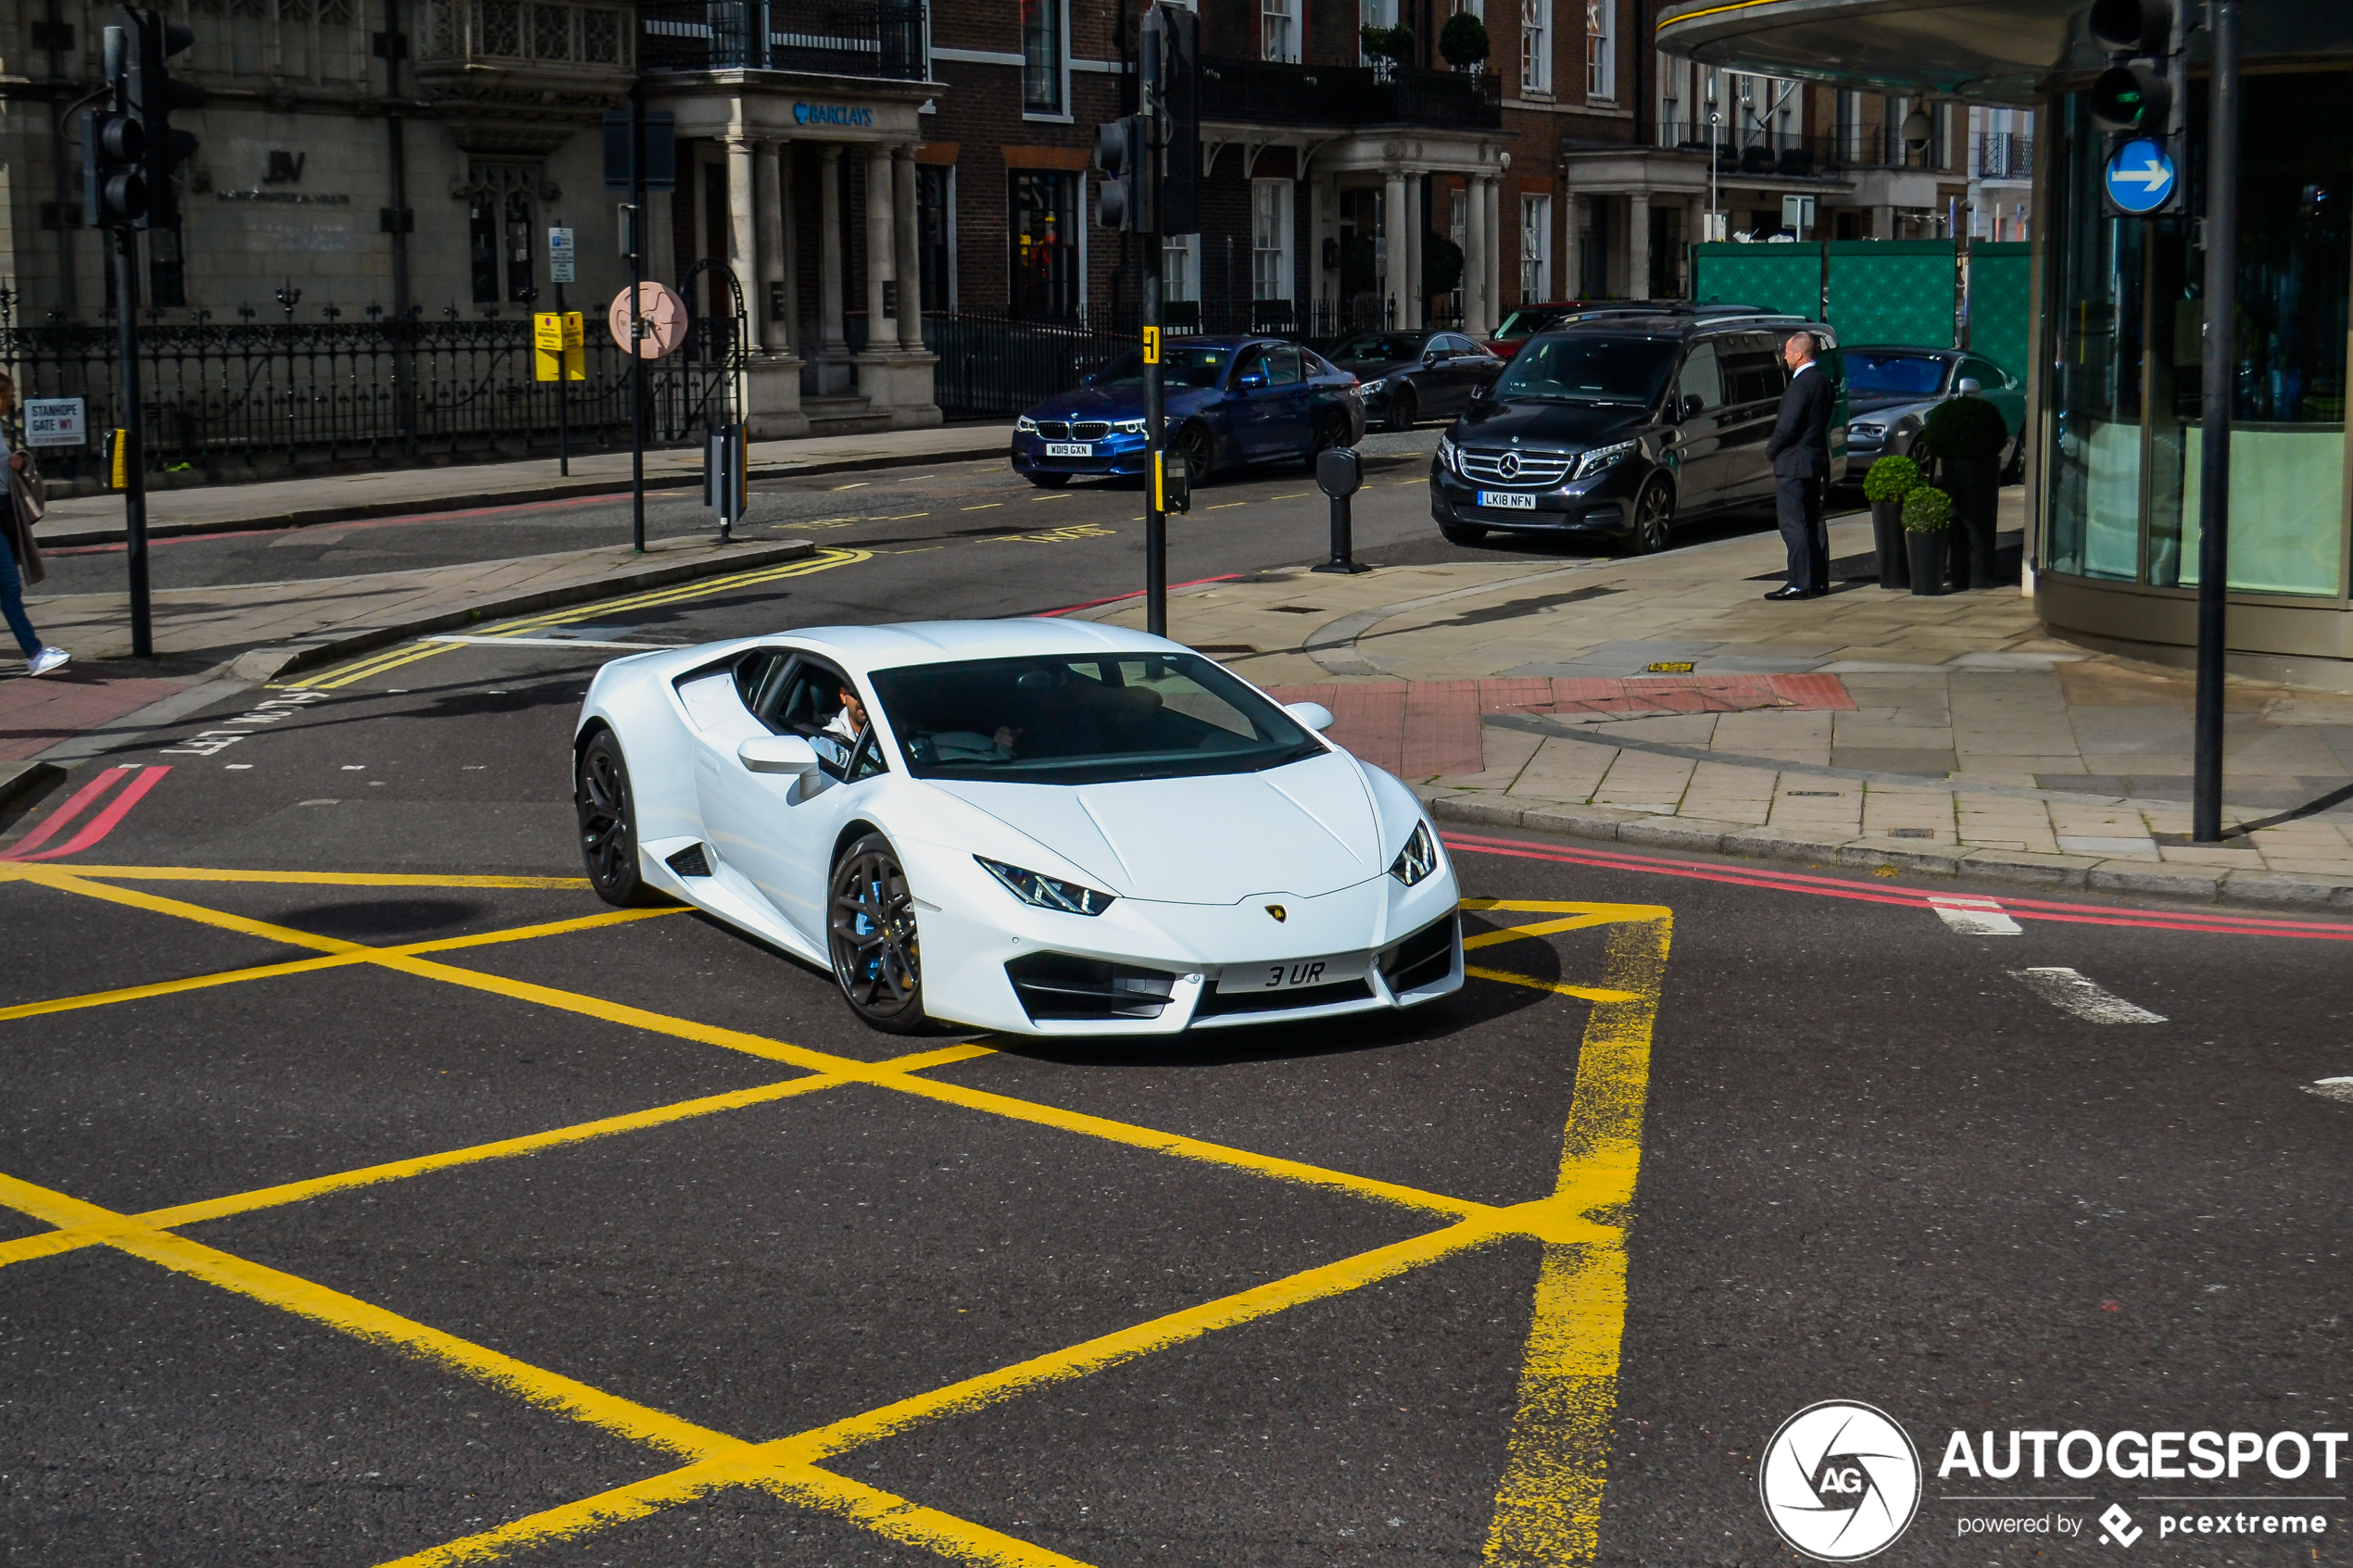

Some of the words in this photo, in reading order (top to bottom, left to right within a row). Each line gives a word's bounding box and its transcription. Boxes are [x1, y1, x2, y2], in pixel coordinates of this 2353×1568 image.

[811, 105, 874, 126] BARCLAYS
[31, 404, 78, 417] STANHOPE
[32, 420, 56, 431] GATE
[59, 419, 73, 430] W1
[1051, 445, 1068, 455] WD19
[1071, 445, 1087, 455] GXN
[1486, 494, 1508, 506] LK18
[1511, 495, 1531, 507] NFN
[1265, 966, 1285, 987] 3
[1290, 961, 1326, 985] UR
